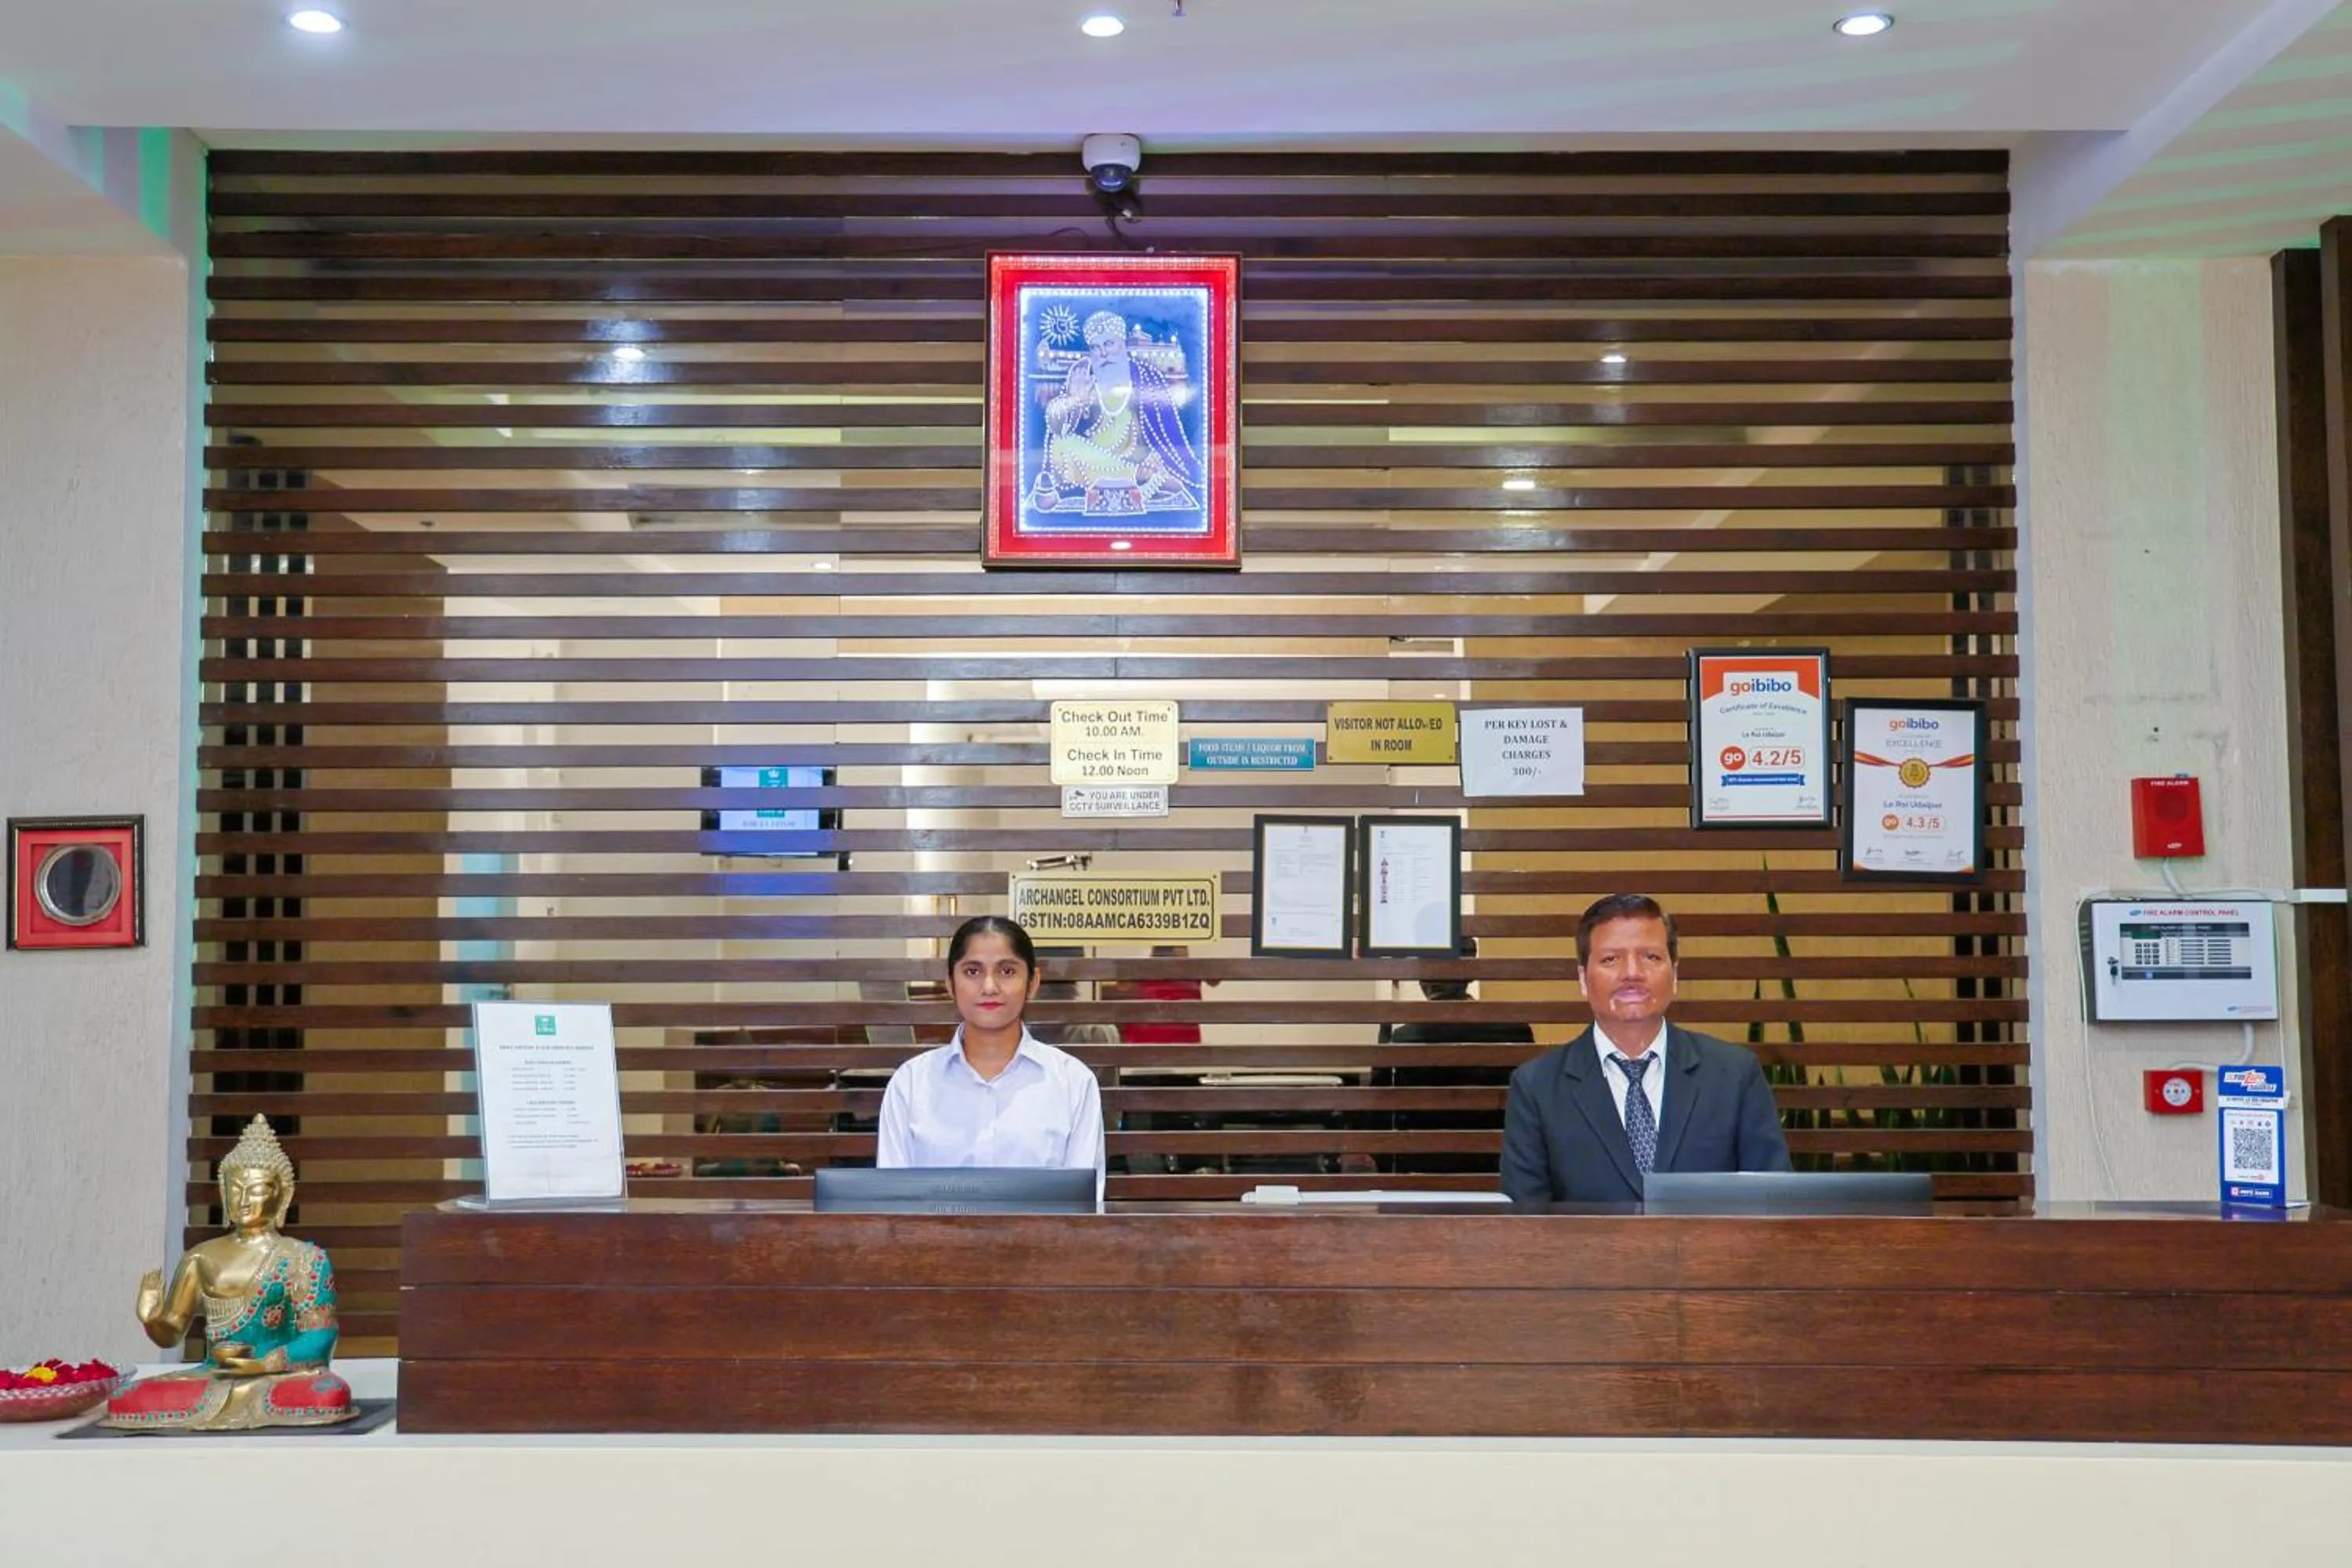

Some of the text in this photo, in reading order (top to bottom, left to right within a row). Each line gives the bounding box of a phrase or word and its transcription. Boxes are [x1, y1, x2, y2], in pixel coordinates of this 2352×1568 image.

[1730, 678, 1792, 696] goibibo
[1061, 710, 1168, 723] Check Out Time
[1334, 717, 1373, 730] VISITOR
[1374, 717, 1395, 730] NOT
[1485, 719, 1567, 730] PER KEY LOST &
[1889, 717, 1940, 731] goibibo
[1085, 725, 1118, 737] 10.00
[1370, 739, 1413, 751] IN ROOM
[1504, 735, 1550, 744] DAMAGE
[1067, 749, 1163, 761] Check In Time
[1501, 750, 1552, 760] CHARGES
[1752, 749, 1802, 766] 4.2/5
[1081, 764, 1149, 776] 12.00 Noon
[1091, 790, 1160, 800] YOU ARE UNDER
[1069, 801, 1161, 811] CCTV SURVEILLANCE
[1906, 816, 1940, 829] 4.3/5
[1018, 887, 1210, 906] ARCHANGEL CONSORTIUM PVT LTD.
[1018, 912, 1210, 930] GSTIN:08AAMCA6339B1ZQ
